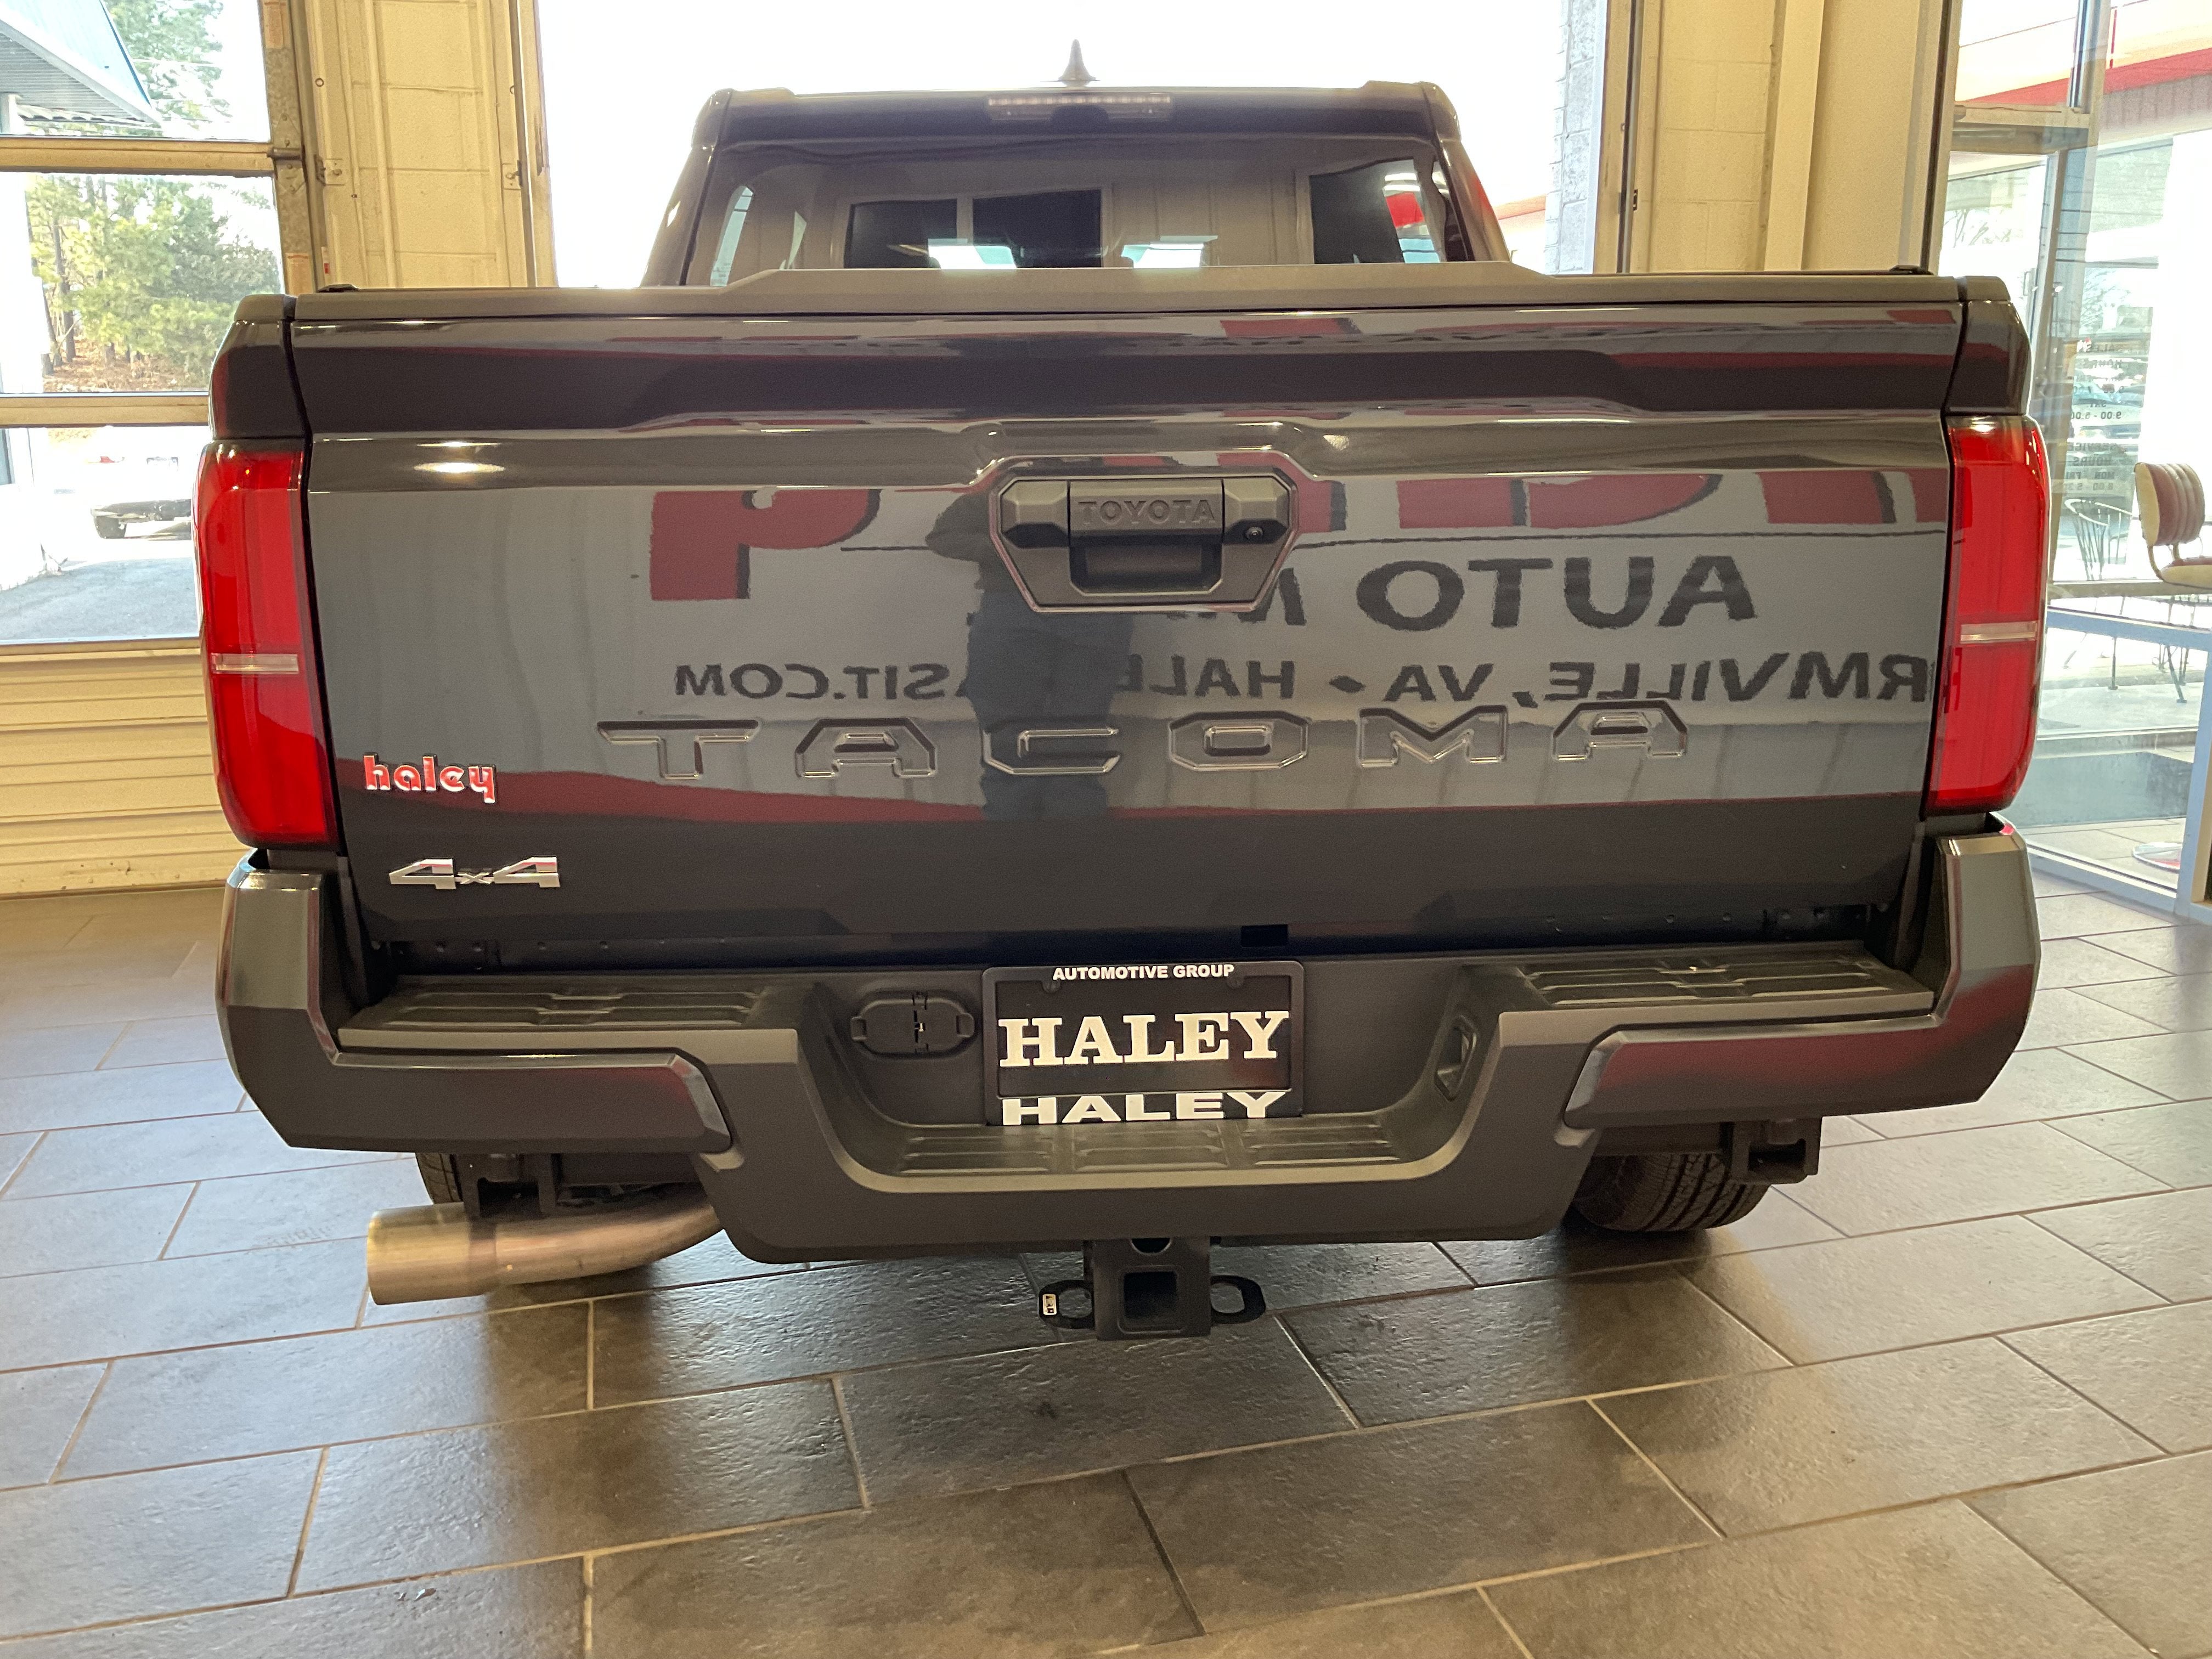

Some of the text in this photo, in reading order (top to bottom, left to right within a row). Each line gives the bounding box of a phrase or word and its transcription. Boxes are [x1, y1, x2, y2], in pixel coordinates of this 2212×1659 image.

[1077, 499, 1216, 526] TOYOTA
[596, 699, 1689, 780] TACOMA
[363, 752, 497, 804] haley
[388, 856, 561, 890] 4x4
[1052, 963, 1235, 980] AUTOMOTIVE GROUP
[998, 1011, 1289, 1067] HALEY
[1002, 1091, 1286, 1126] HALEY
